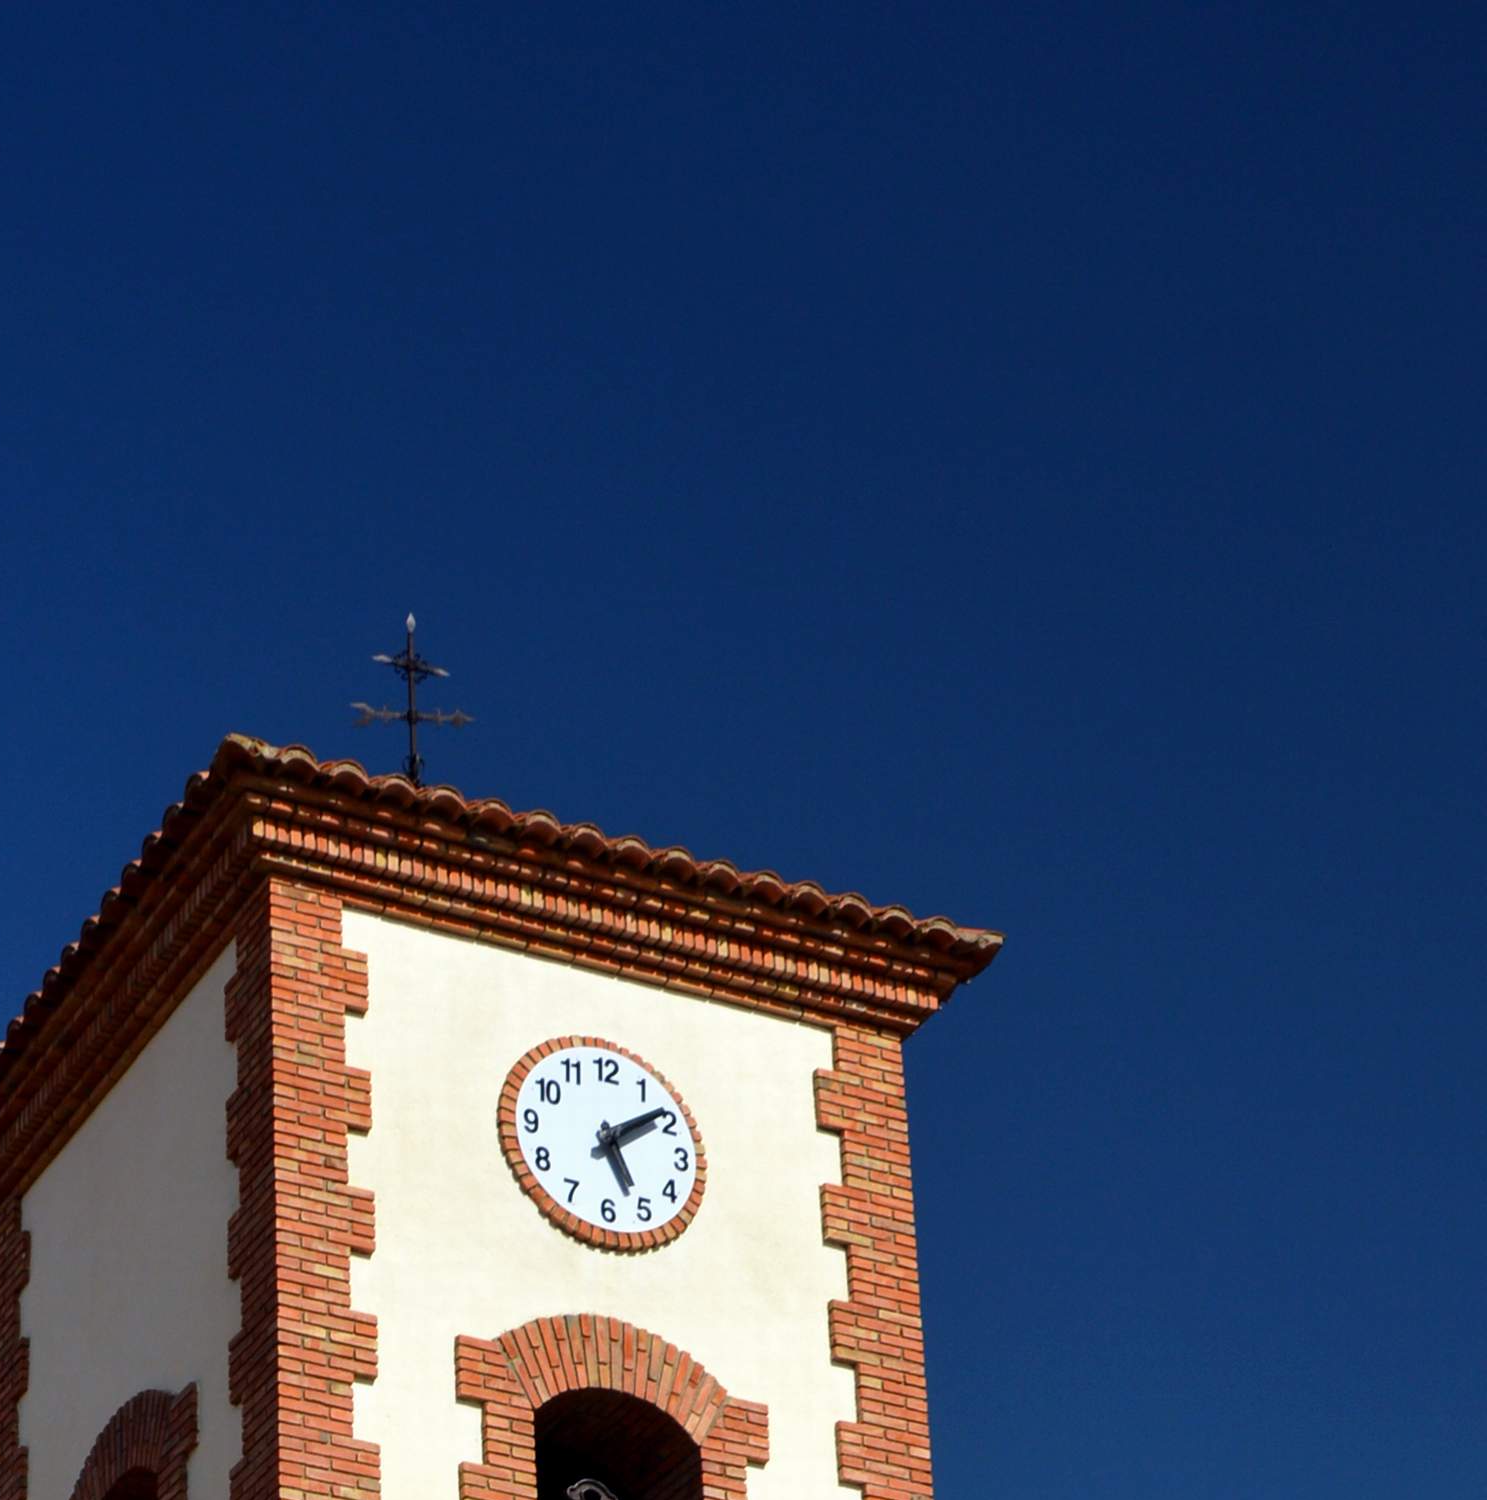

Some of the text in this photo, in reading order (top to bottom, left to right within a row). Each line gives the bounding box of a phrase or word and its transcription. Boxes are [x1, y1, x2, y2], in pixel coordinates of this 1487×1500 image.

[561, 1058, 581, 1085] 11
[593, 1057, 619, 1085] 12
[536, 1078, 561, 1105] 10
[636, 1078, 646, 1102] 1
[523, 1109, 539, 1133] 9
[662, 1110, 677, 1136] 2
[535, 1147, 551, 1172] 8
[674, 1148, 689, 1172] 3
[563, 1177, 580, 1203] 7
[662, 1179, 678, 1204] 4
[600, 1198, 616, 1223] 6
[636, 1197, 652, 1222] 5
